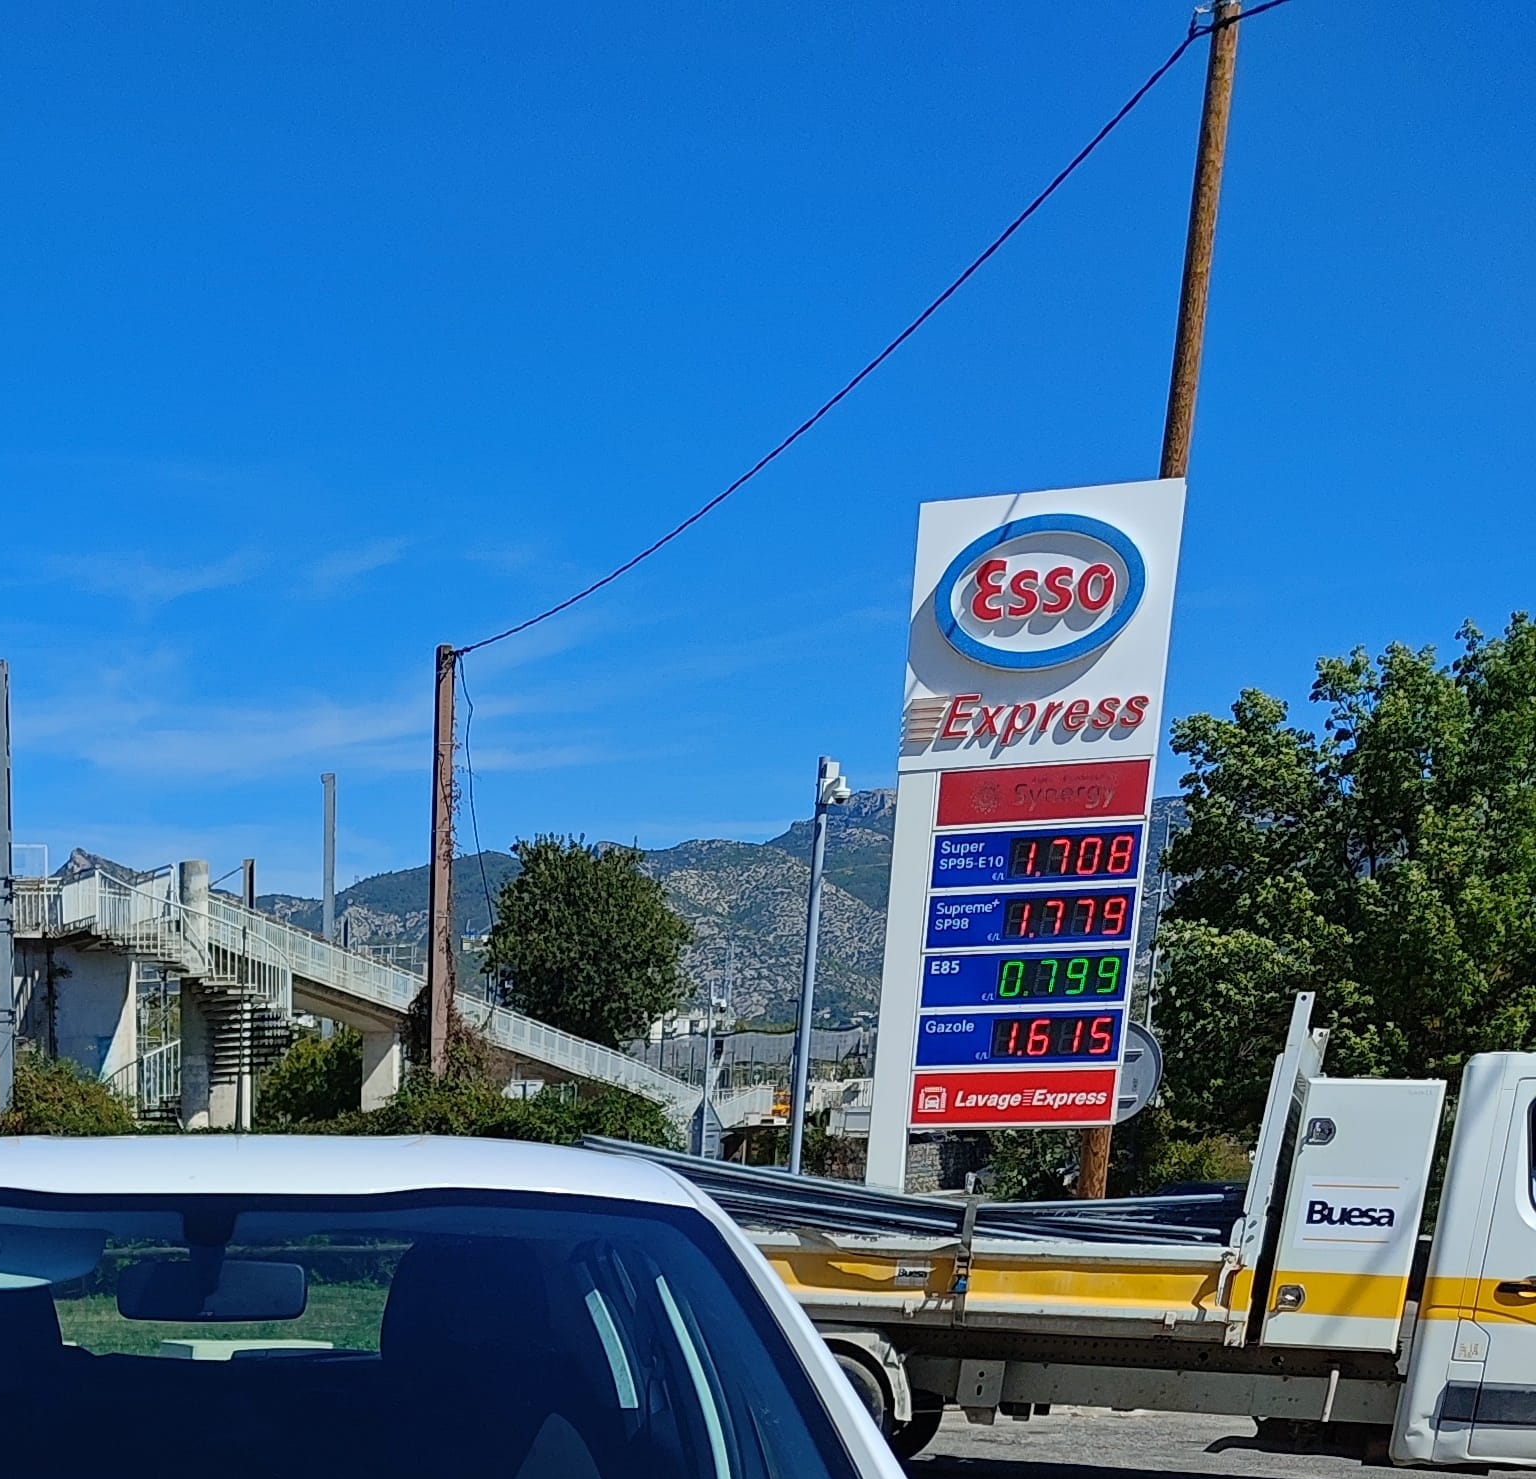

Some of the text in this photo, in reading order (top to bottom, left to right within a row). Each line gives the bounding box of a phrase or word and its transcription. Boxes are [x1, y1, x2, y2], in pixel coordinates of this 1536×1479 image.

[940, 693, 1151, 746] Express
[1015, 783, 1113, 812] Synergy
[941, 840, 986, 856] Super
[1026, 835, 1134, 877] 1.708
[939, 855, 1004, 870] SP95-E10
[991, 871, 1005, 881] €/L
[934, 918, 970, 931] SP98
[1020, 897, 1127, 938] 1.779
[986, 932, 1001, 942] €/L
[930, 960, 961, 975] E85
[999, 957, 1121, 997] 0.799
[981, 992, 995, 1001] €/L
[925, 1020, 975, 1034] Gazole
[1007, 1017, 1113, 1056] 1.615
[975, 1051, 989, 1060] €/L
[954, 1089, 1108, 1109] Lavage Express
[1305, 1200, 1395, 1227] Buesa
